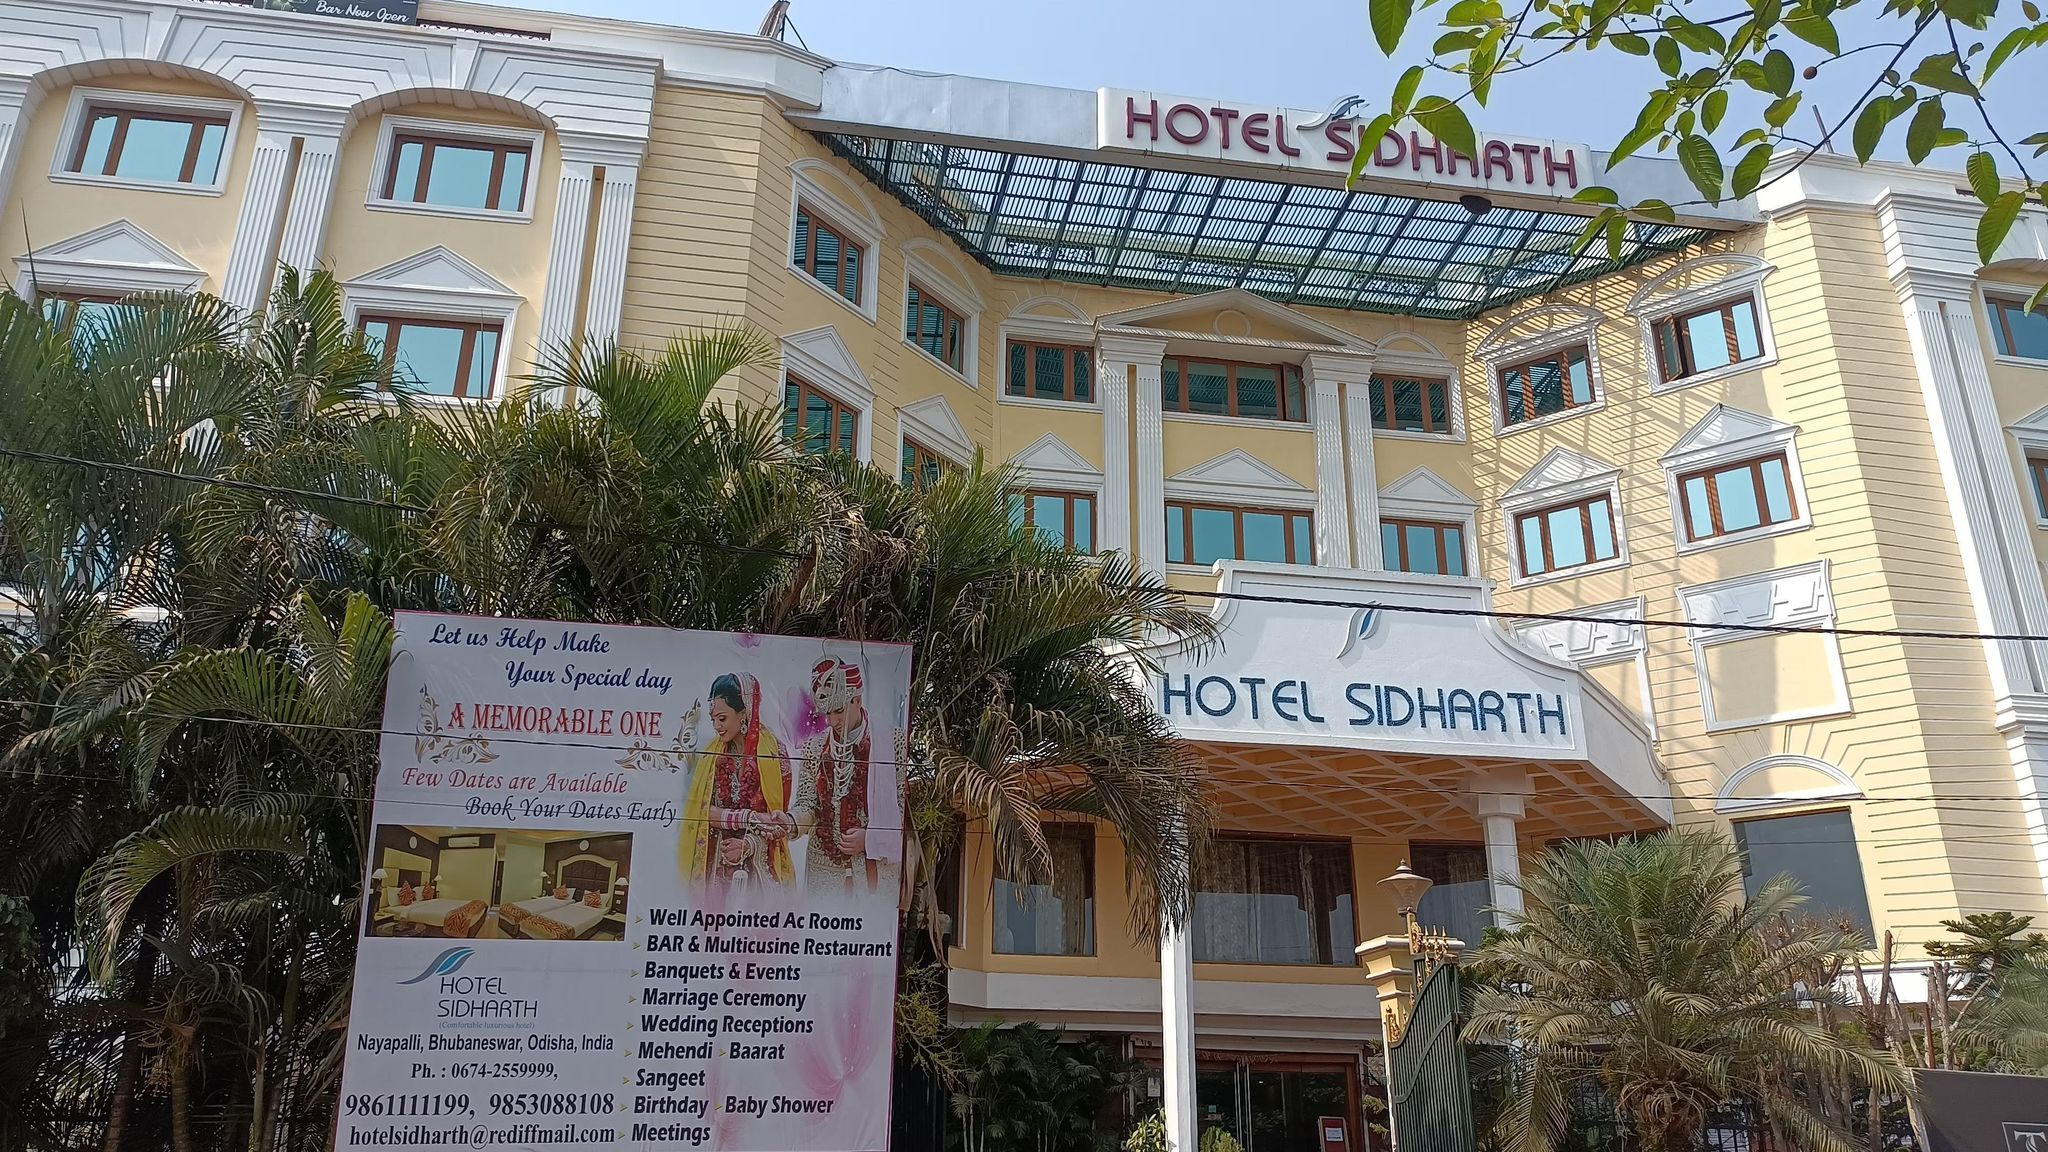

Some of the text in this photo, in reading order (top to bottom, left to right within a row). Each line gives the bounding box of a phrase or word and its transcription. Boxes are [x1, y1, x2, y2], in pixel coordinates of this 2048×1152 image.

[316, 0, 409, 22] Bar Now Open
[1126, 96, 1301, 157] HOTEL
[429, 623, 610, 655] Let us Help Make
[505, 660, 672, 695] Your Special day
[1163, 672, 1567, 735] HOTEL SIDHARTH
[448, 702, 663, 738] A MEMORABLE ONE
[402, 767, 628, 794] Few Dates are Available
[465, 795, 677, 827] Book Your Dates Early
[650, 909, 863, 931] Well Appointed Ac Rooms
[646, 935, 892, 957] BAR & Multicusine Restaurant
[644, 961, 800, 984] Banquets & Events
[440, 976, 507, 995] HOTEL
[437, 1000, 538, 1018] SIDHARTH
[642, 988, 806, 1012] Marriage Ceremony
[641, 1014, 814, 1037] Wedding Receptions
[358, 1034, 614, 1054] Nayapalli, Bhubaneswar, Odisha, India
[638, 1042, 785, 1060] Mehendi Baarat
[411, 1063, 436, 1078] Ph.
[451, 1062, 558, 1080] 0674-2559999,
[636, 1068, 705, 1091] Sangeet
[344, 1093, 614, 1119] 9861111199, 9853088108
[634, 1096, 834, 1118] Birthday Baby Shower
[349, 1124, 615, 1150] hotelsidharth@rediffmail.com
[632, 1123, 711, 1146] Meetings
